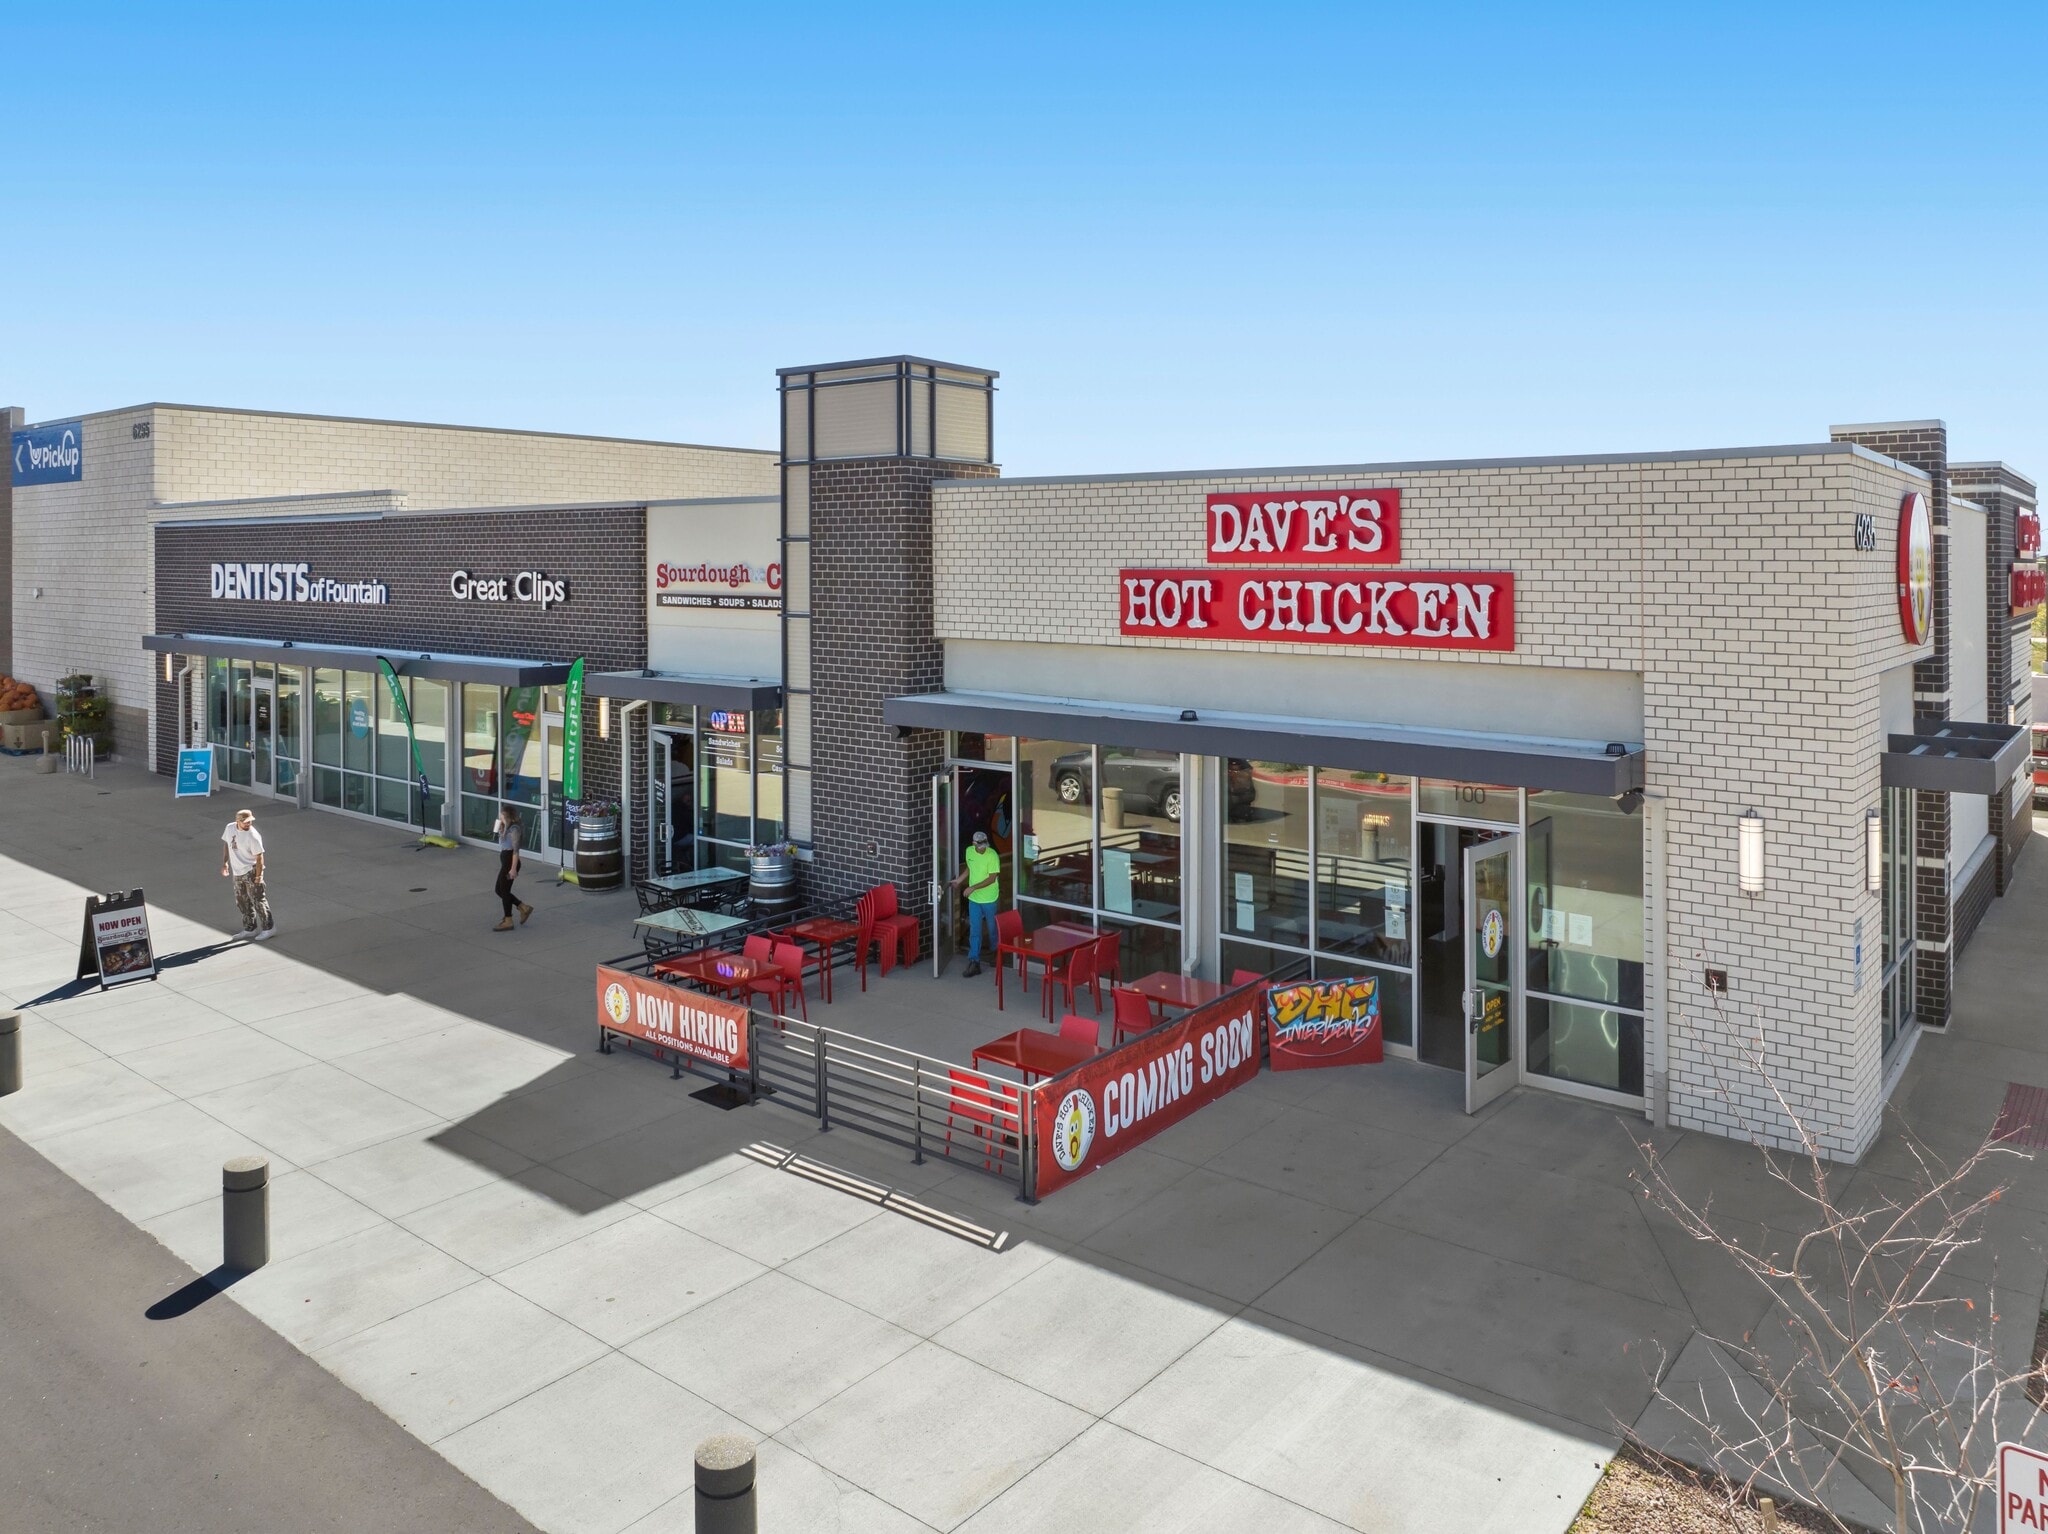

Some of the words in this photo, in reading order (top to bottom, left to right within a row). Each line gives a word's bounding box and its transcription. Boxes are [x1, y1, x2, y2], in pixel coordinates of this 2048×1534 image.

[132, 422, 150, 440] 6255
[1210, 495, 1384, 553] DAVE'S
[211, 562, 310, 602] DENTISTS
[310, 578, 325, 601] of
[326, 579, 386, 604] Fountain
[450, 570, 508, 601] Great
[514, 571, 566, 610] Clips
[656, 563, 751, 588] Sourdough
[662, 595, 712, 606] SANDWICHES
[718, 598, 745, 607] SOUPS
[1124, 578, 1213, 628] HOT
[1238, 580, 1495, 640] CHICKEN
[710, 711, 745, 733] OPEN
[708, 737, 741, 748] Sandwiches
[1453, 785, 1485, 804] 100
[99, 920, 119, 932] NOW
[120, 916, 142, 928] OPEN
[636, 992, 674, 1034] NOW
[679, 1004, 738, 1055] HIRING
[645, 1030, 657, 1041] ALL
[657, 1033, 694, 1053] POSITIONS
[694, 1045, 730, 1064] AVAILABLE
[1103, 1042, 1193, 1138] COMING
[1200, 1010, 1253, 1084] SOON
[1059, 1098, 1073, 1121] HOT
[1055, 1122, 1066, 1160] DAVE'S
